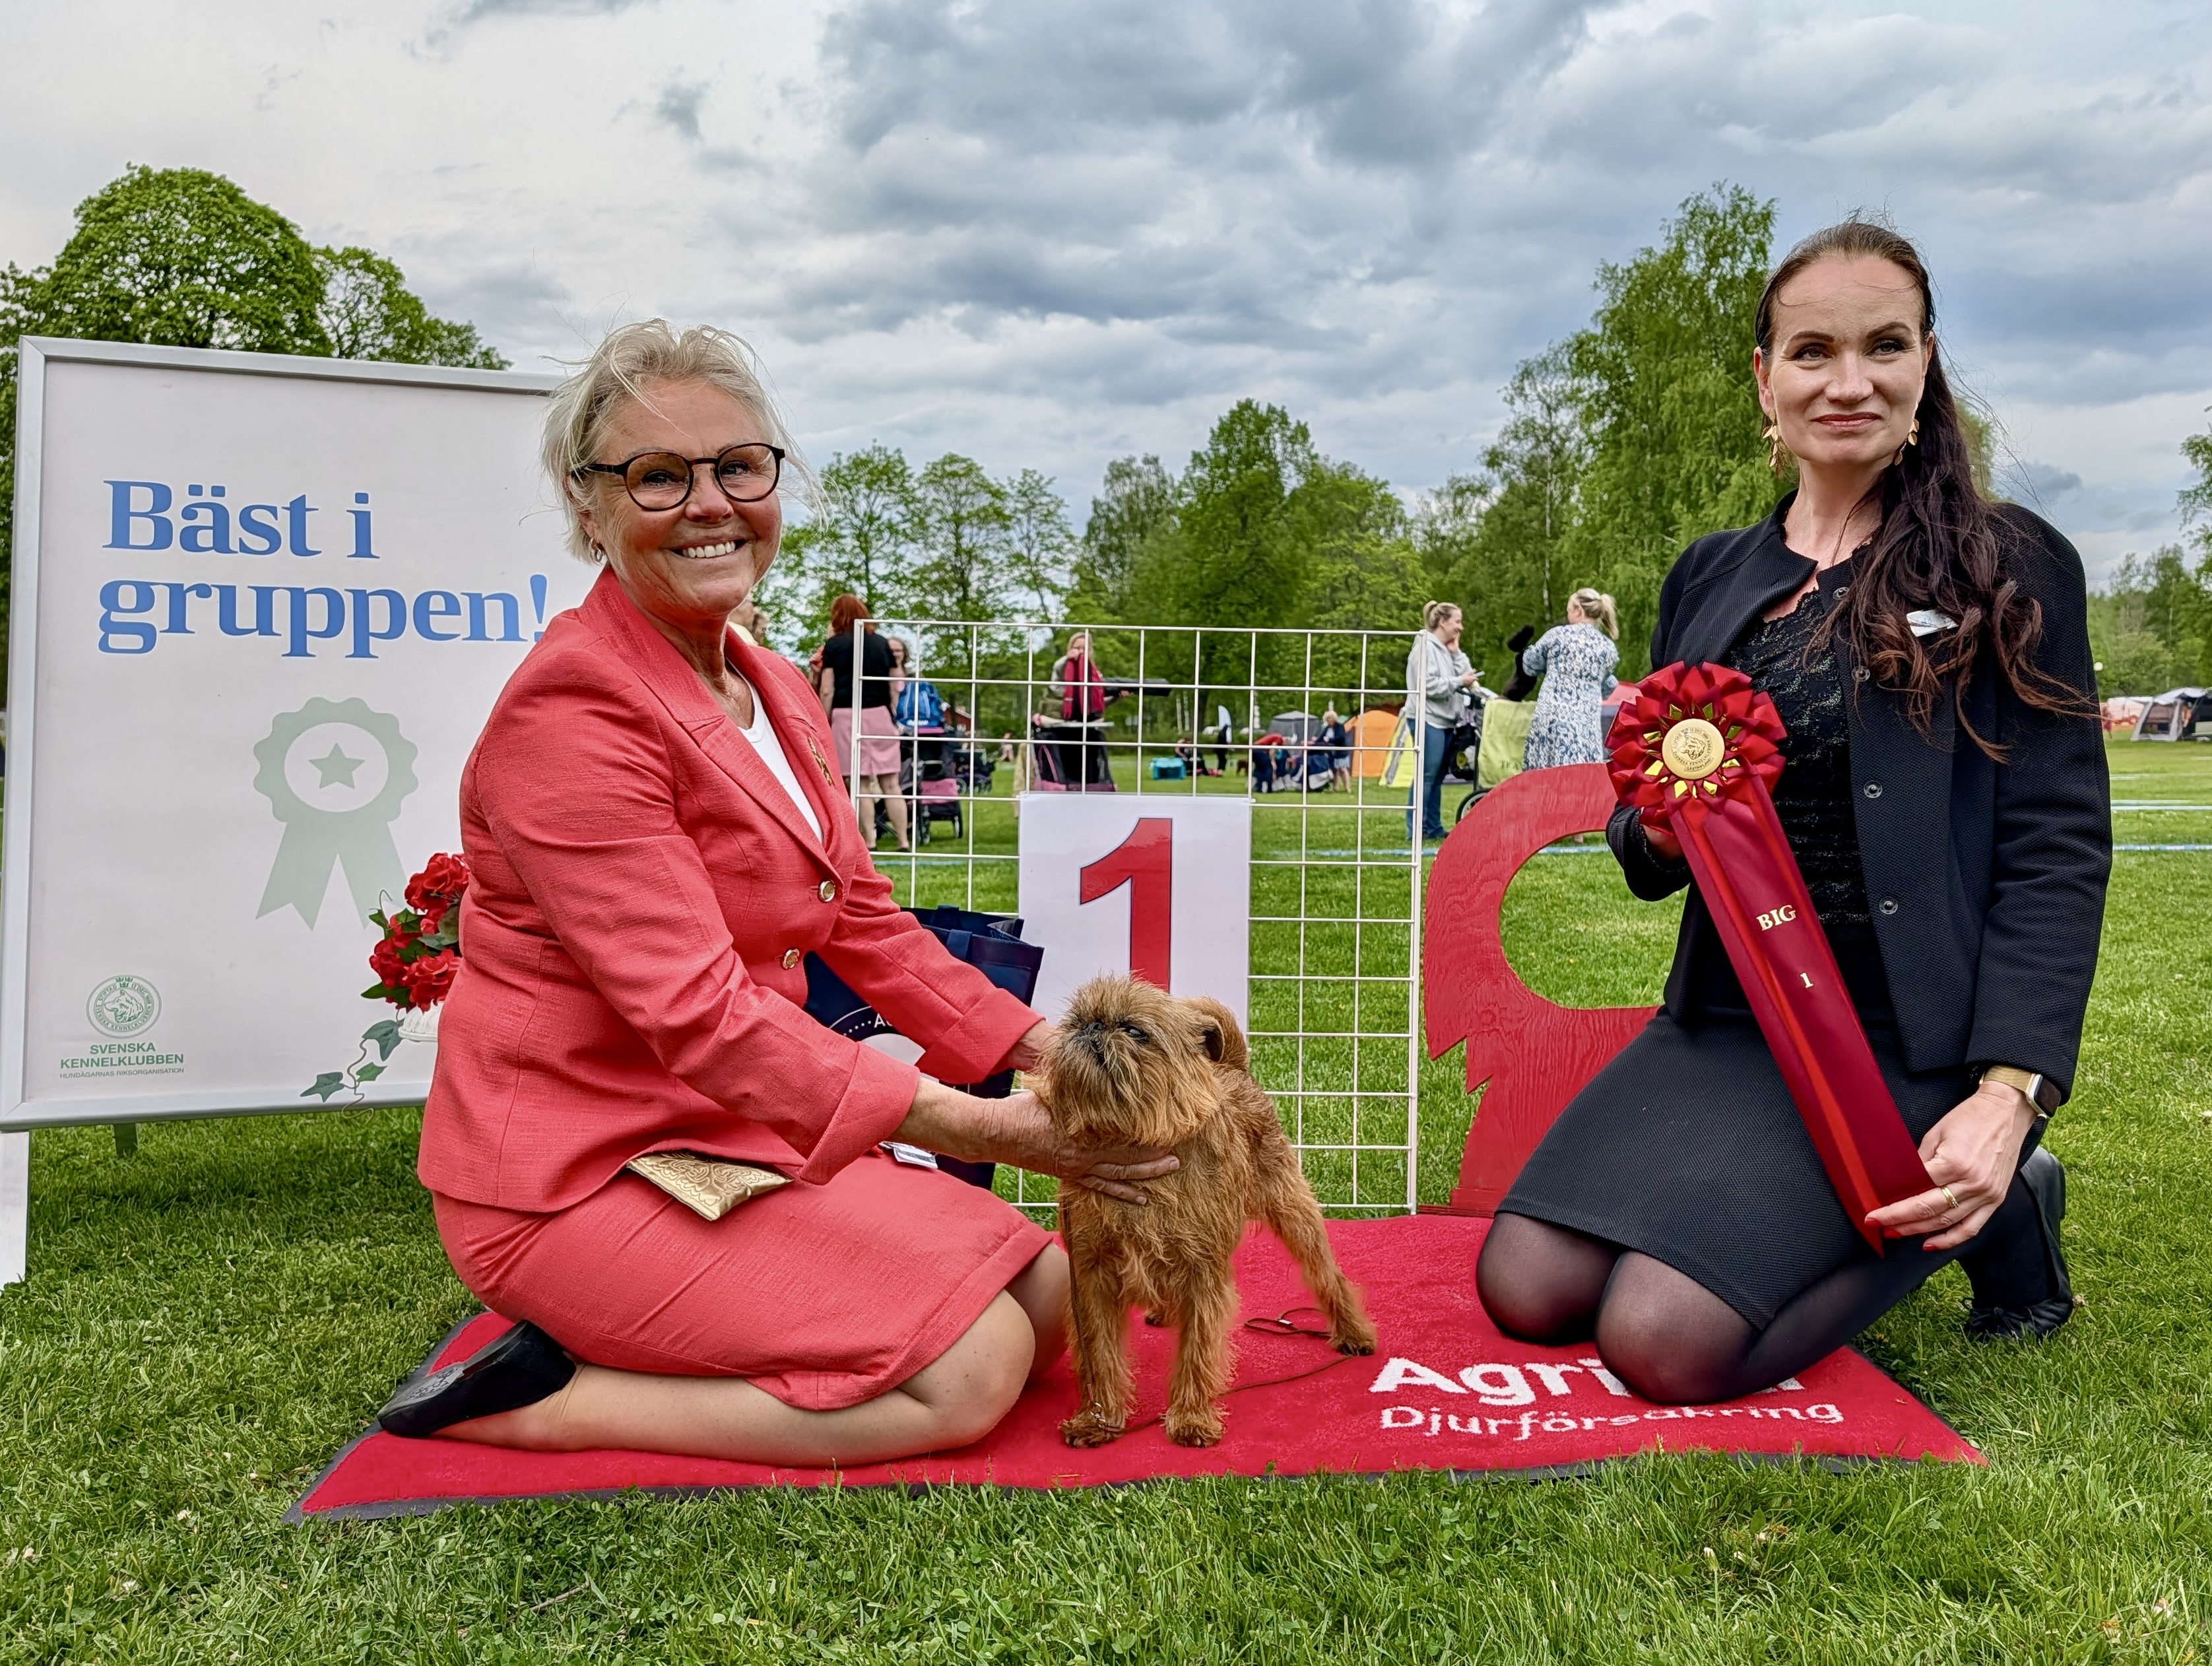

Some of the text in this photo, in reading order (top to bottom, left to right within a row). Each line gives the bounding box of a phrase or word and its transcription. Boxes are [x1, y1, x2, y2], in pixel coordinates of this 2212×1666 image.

[102, 480, 380, 559] Bäst i
[98, 574, 548, 658] gruppen!
[1079, 817, 1173, 995] 1
[1756, 904, 1796, 931] BIG
[1800, 972, 1813, 988] 1
[60, 1054, 184, 1069] KENNELKLUBBEN
[90, 1042, 156, 1055] SVENSKA
[59, 1067, 185, 1079] HUNDÄGARNAS RIKSORGANISATION
[1369, 1357, 1807, 1406] Agri
